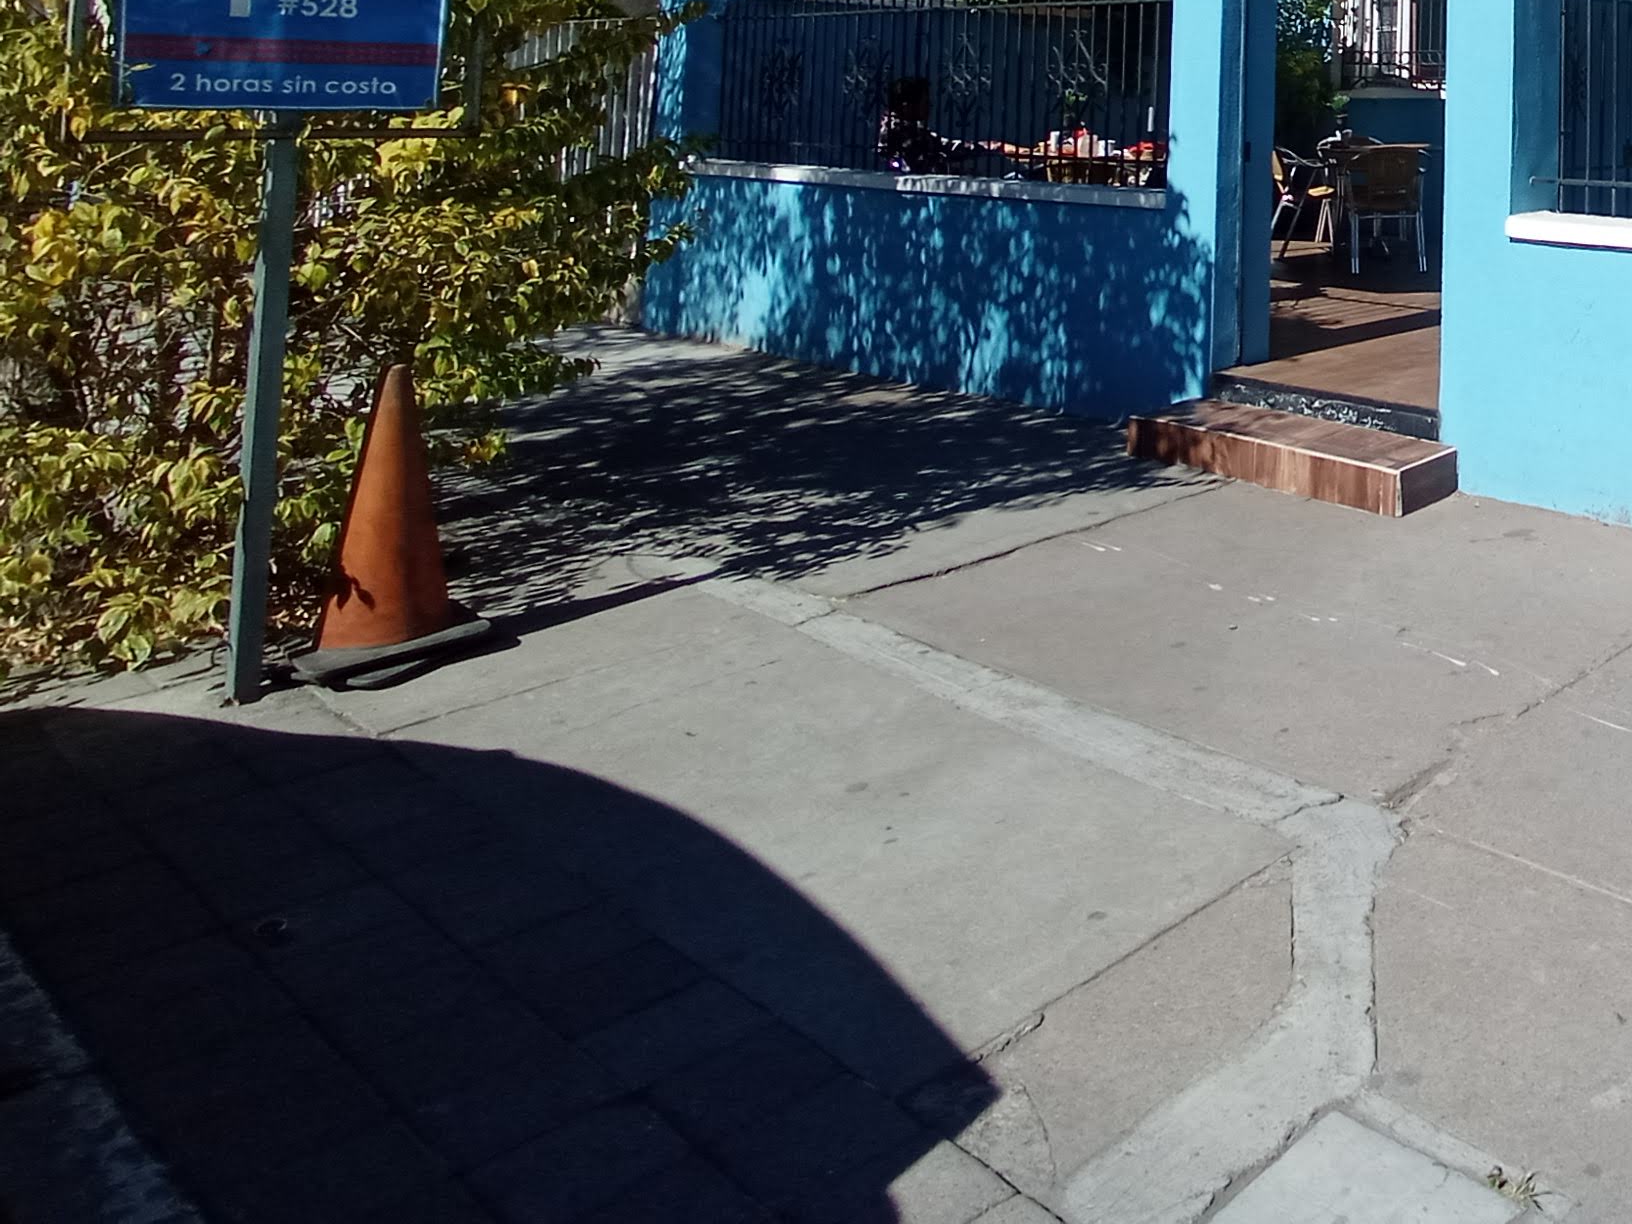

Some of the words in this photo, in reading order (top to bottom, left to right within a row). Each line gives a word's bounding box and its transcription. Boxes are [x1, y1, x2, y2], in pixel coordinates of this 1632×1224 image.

[170, 73, 185, 92] 2
[196, 73, 273, 94] horas
[281, 75, 317, 95] sin
[325, 77, 397, 96] costo
